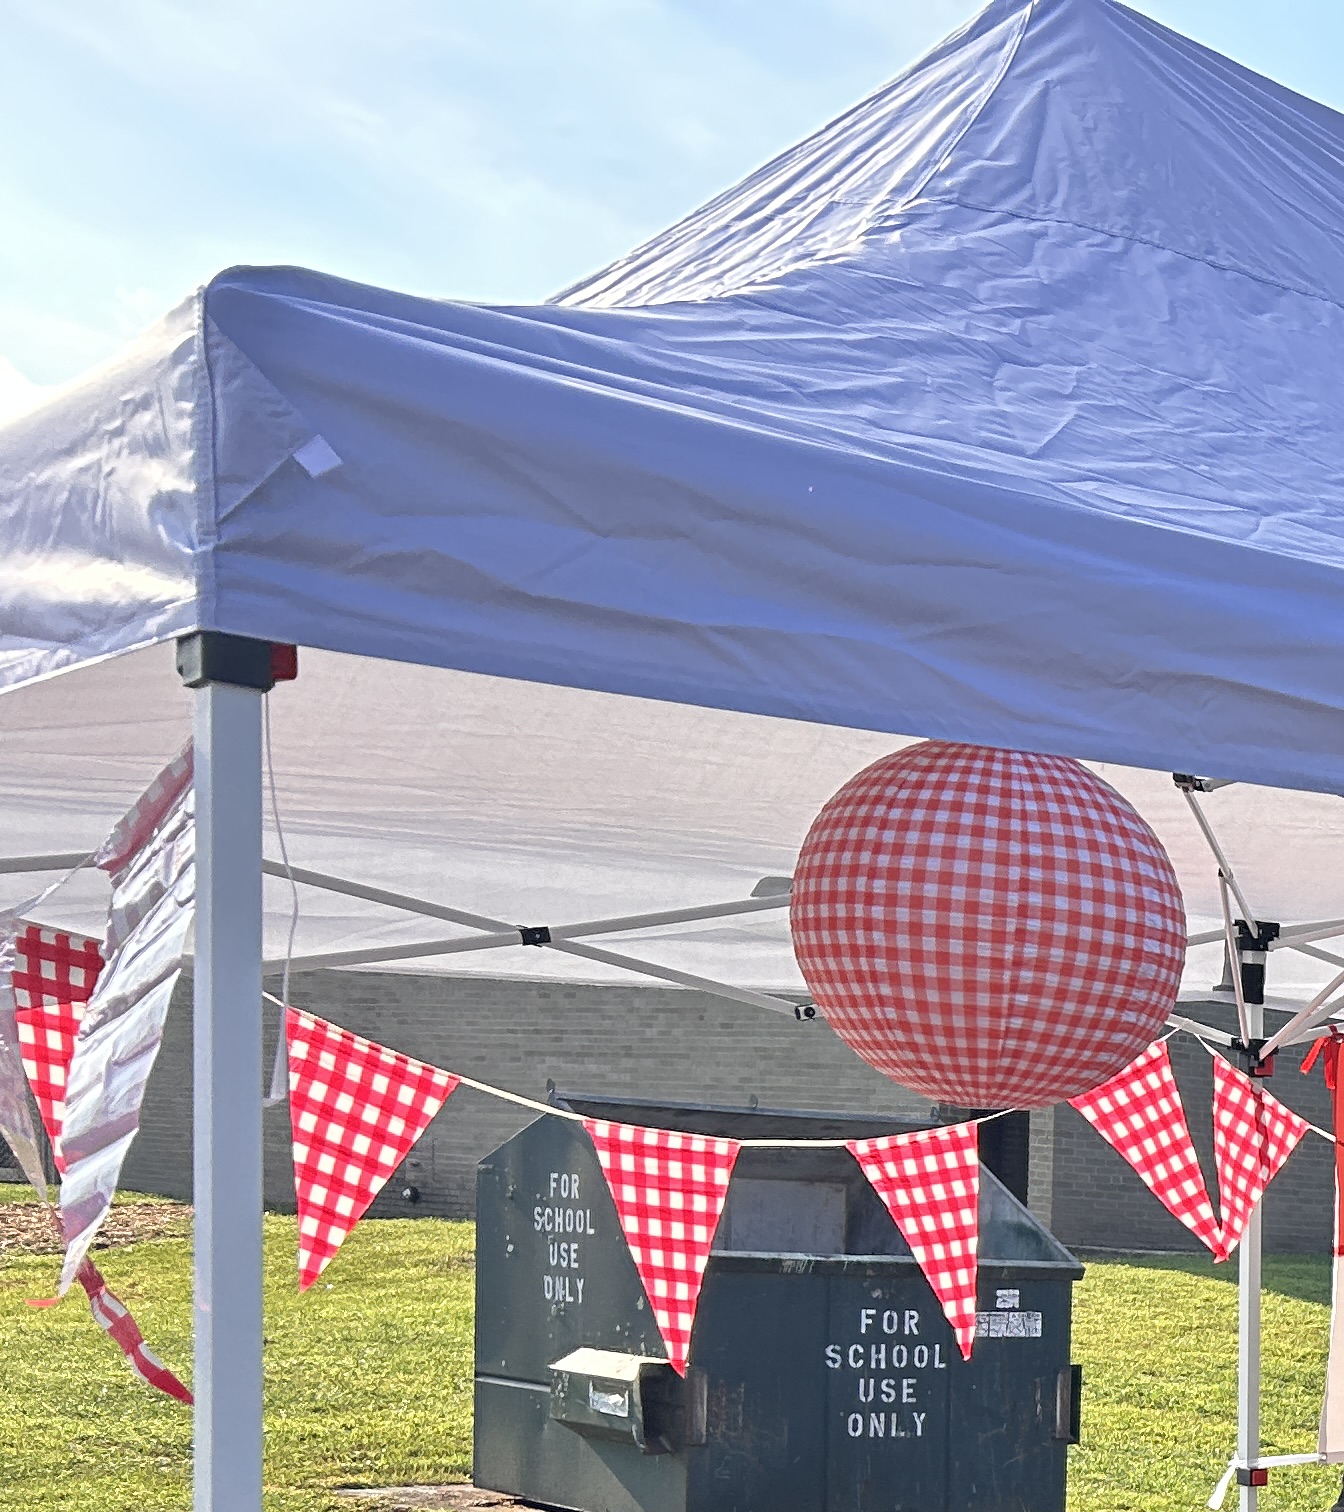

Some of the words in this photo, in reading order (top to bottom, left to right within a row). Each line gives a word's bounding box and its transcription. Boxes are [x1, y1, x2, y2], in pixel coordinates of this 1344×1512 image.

[549, 1172, 580, 1200] FOR
[533, 1206, 595, 1235] SCHOOL
[549, 1242, 579, 1268] USE
[543, 1275, 585, 1304] ONLY
[860, 1308, 920, 1335] FOR
[824, 1343, 947, 1369] SCHOOL
[858, 1378, 918, 1403] USE
[847, 1412, 927, 1438] ONLY
